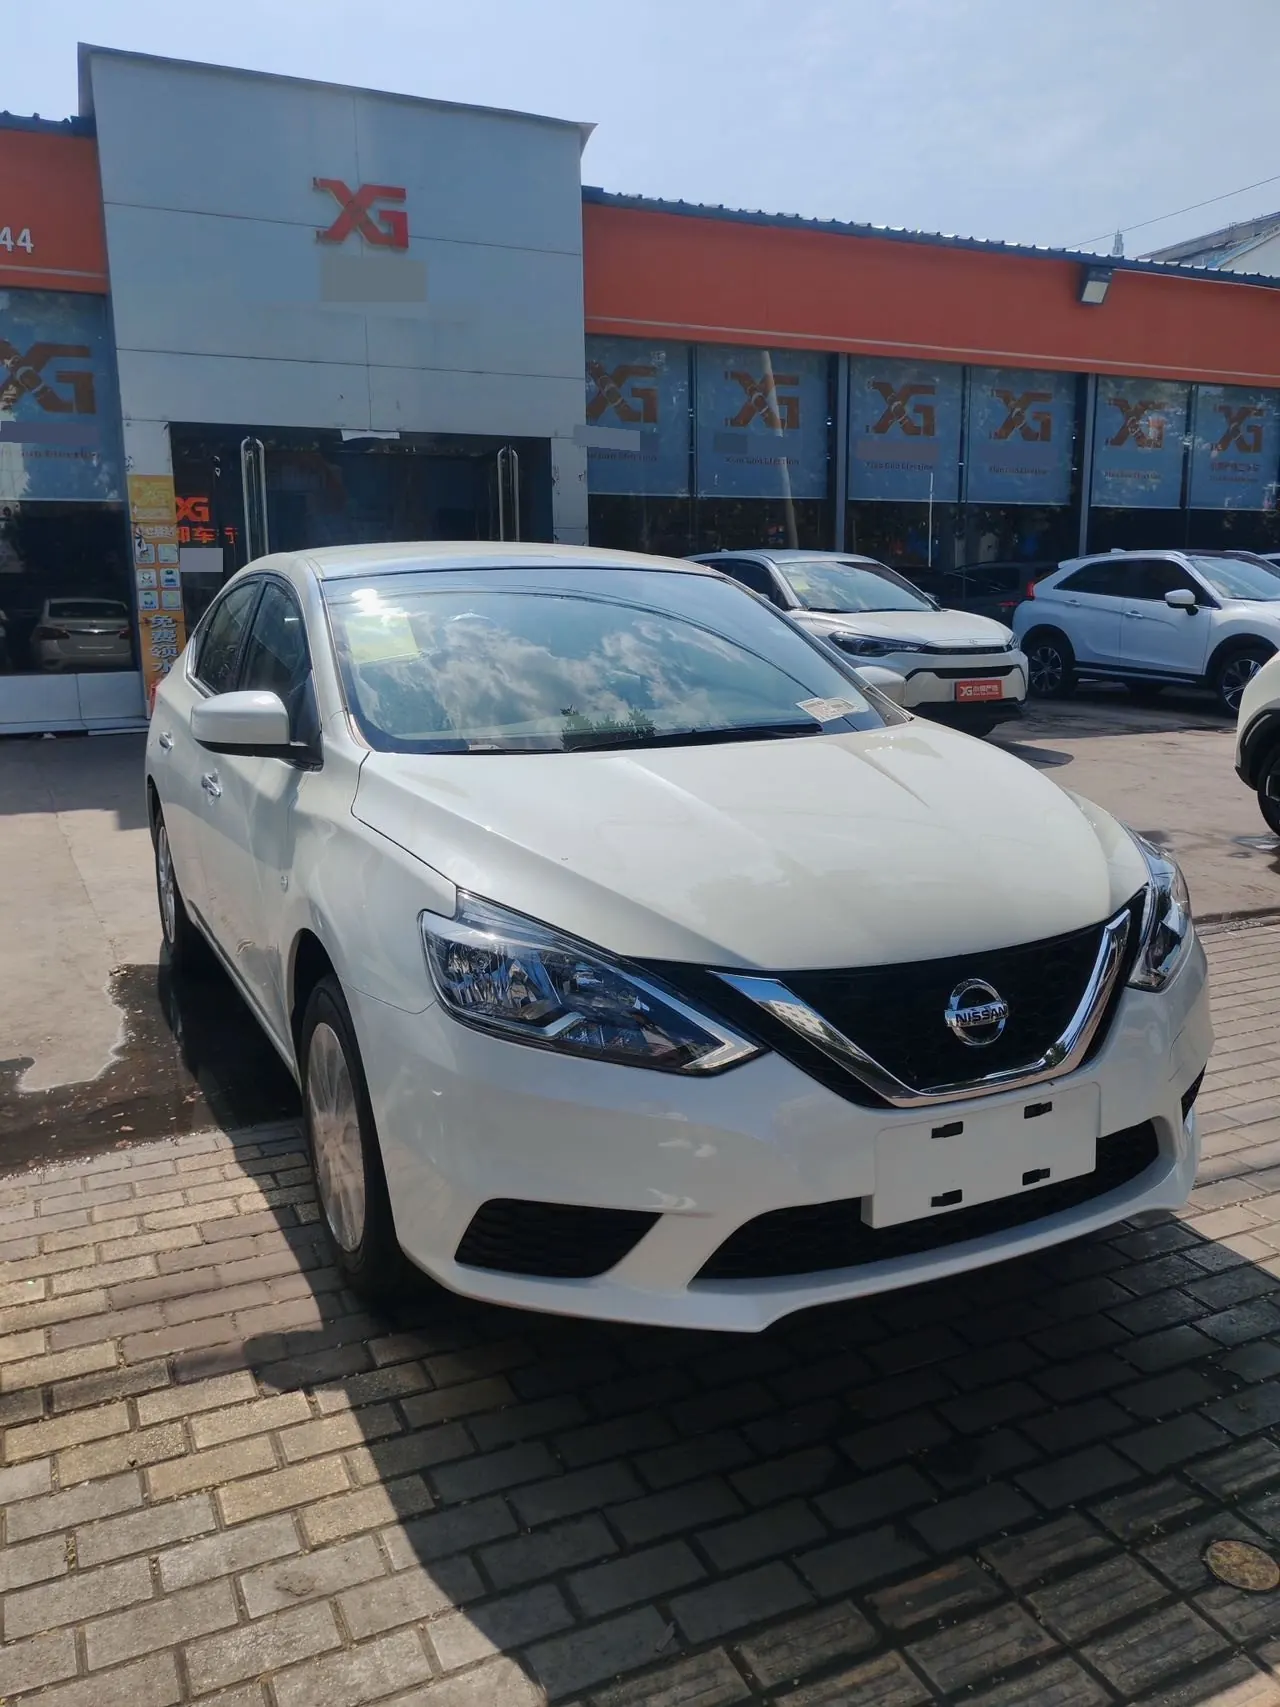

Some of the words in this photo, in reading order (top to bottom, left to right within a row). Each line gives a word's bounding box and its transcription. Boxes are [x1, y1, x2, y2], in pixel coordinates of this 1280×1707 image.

[312, 177, 409, 249] XG
[0, 226, 34, 253] 44
[865, 378, 935, 437] XG
[955, 1006, 1006, 1024] NISSAN
